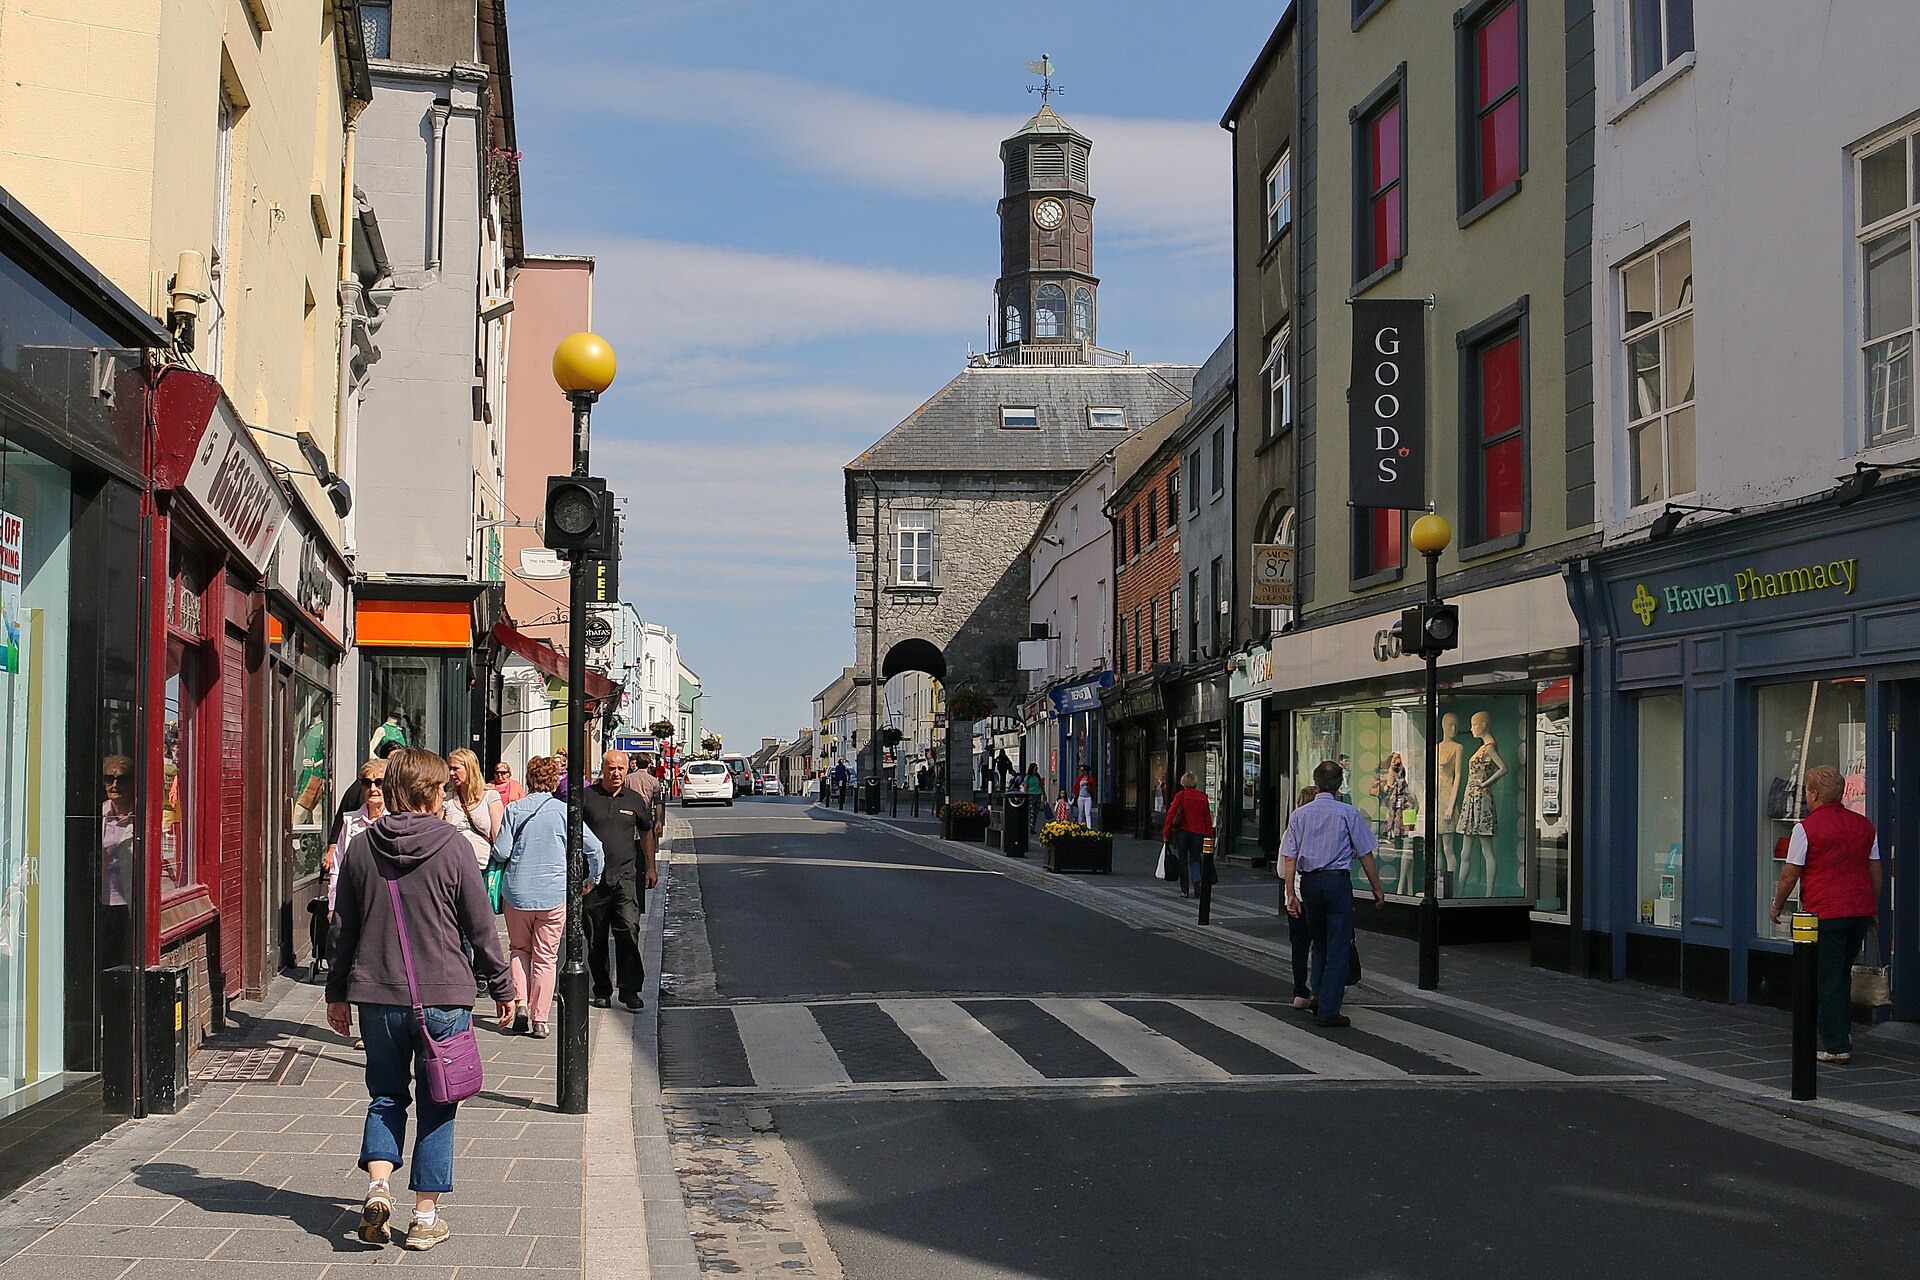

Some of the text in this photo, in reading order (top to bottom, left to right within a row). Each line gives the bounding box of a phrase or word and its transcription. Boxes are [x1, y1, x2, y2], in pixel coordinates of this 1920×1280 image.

[1058, 86, 1065, 95] E
[1374, 327, 1401, 482] GOODS
[201, 430, 218, 466] 15
[4, 516, 21, 547] OFF
[1265, 558, 1290, 577] 87
[1664, 558, 1858, 614] Haven Pharmacy
